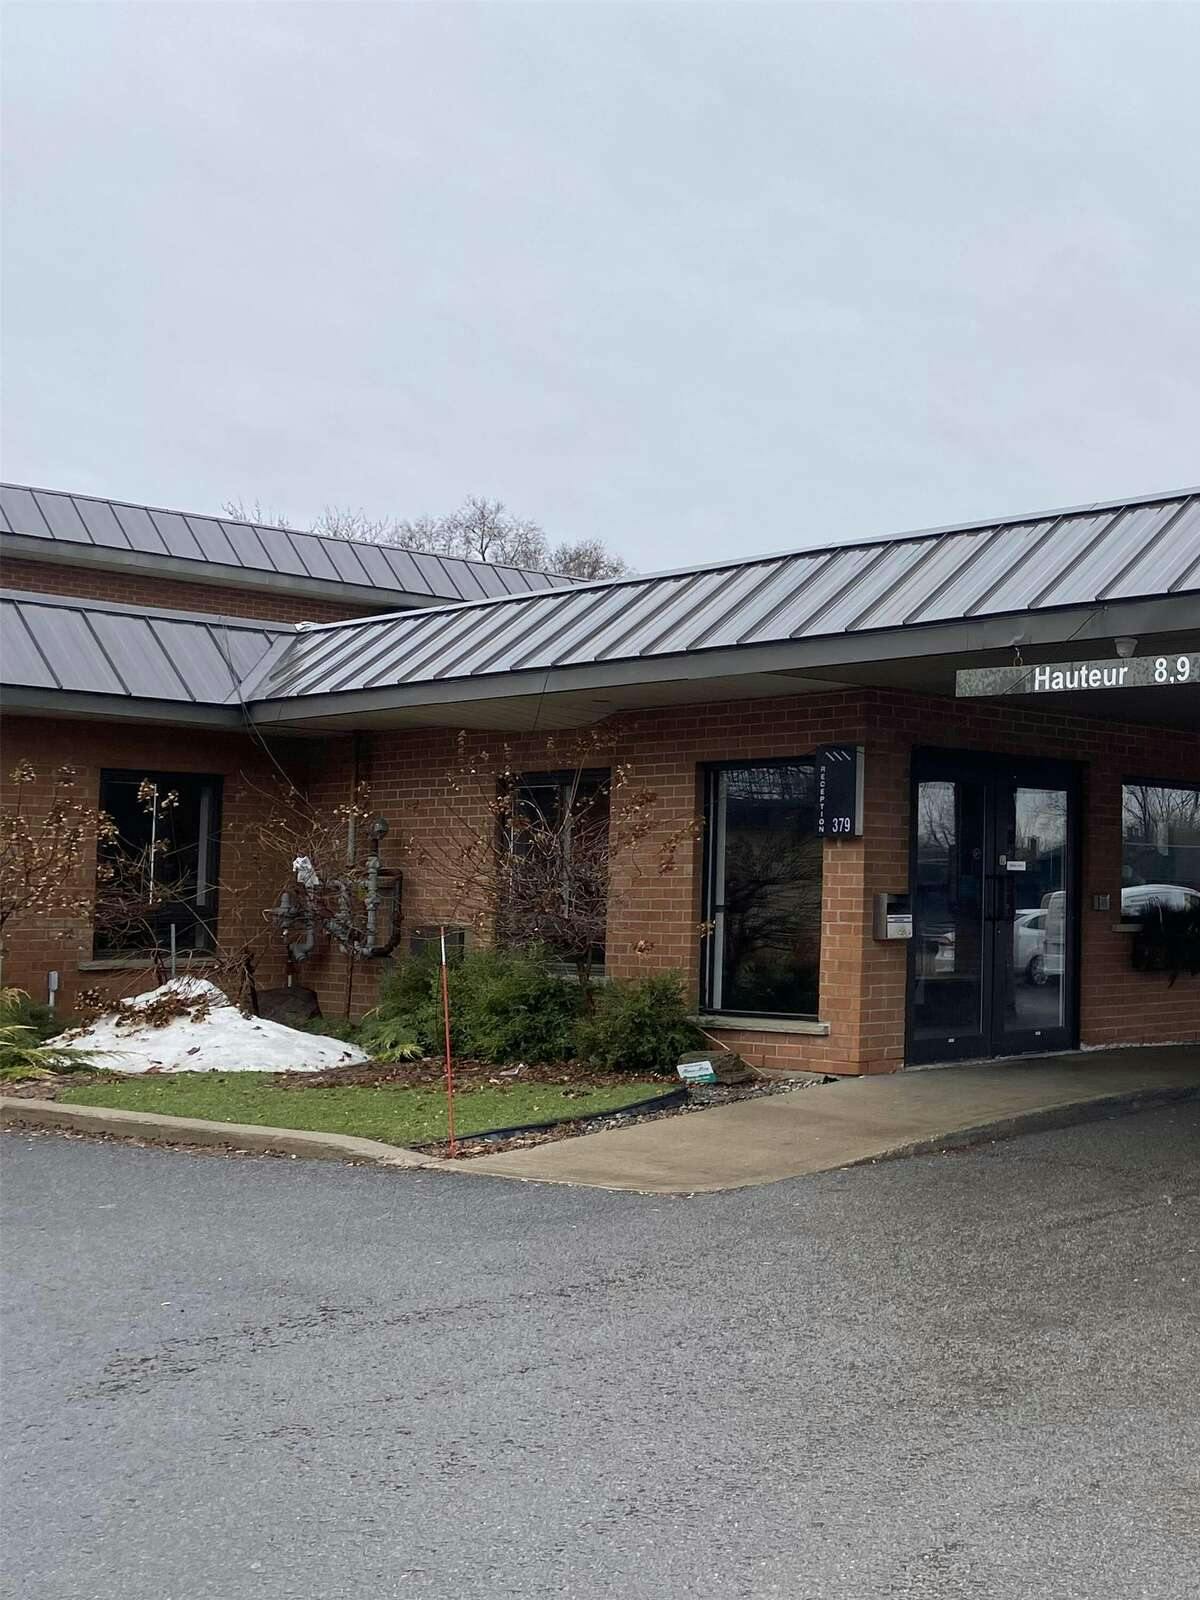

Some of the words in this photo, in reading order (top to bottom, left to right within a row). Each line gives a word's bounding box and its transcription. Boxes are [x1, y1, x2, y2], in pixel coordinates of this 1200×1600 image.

[1034, 664, 1129, 691] Hauteur
[1154, 656, 1190, 684] 8,9
[818, 765, 826, 833] RECEPTION
[832, 817, 851, 833] 379
